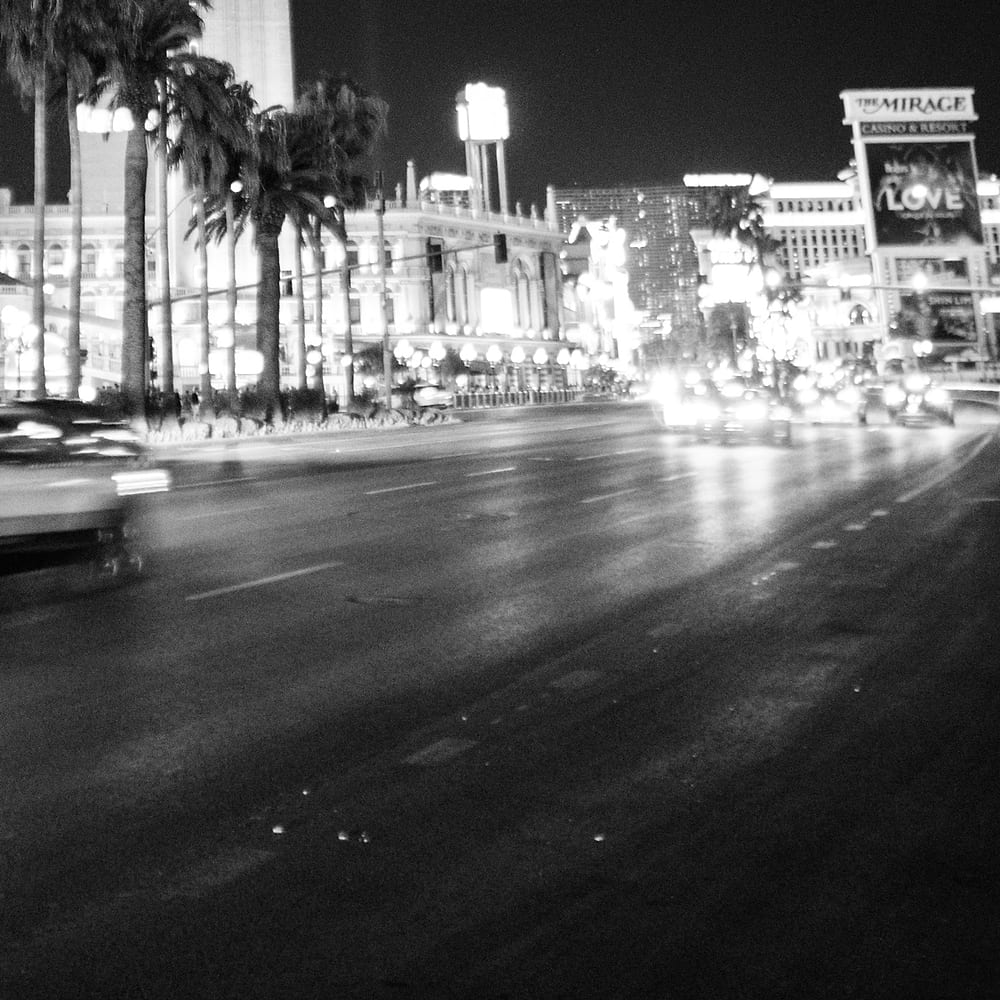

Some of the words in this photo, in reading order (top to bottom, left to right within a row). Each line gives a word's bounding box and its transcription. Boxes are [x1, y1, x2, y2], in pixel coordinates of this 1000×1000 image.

[857, 97, 879, 108] THE
[863, 96, 966, 114] MIRAGE
[862, 123, 906, 134] CASINO
[920, 122, 967, 133] RESORT
[885, 185, 964, 211] LOVE
